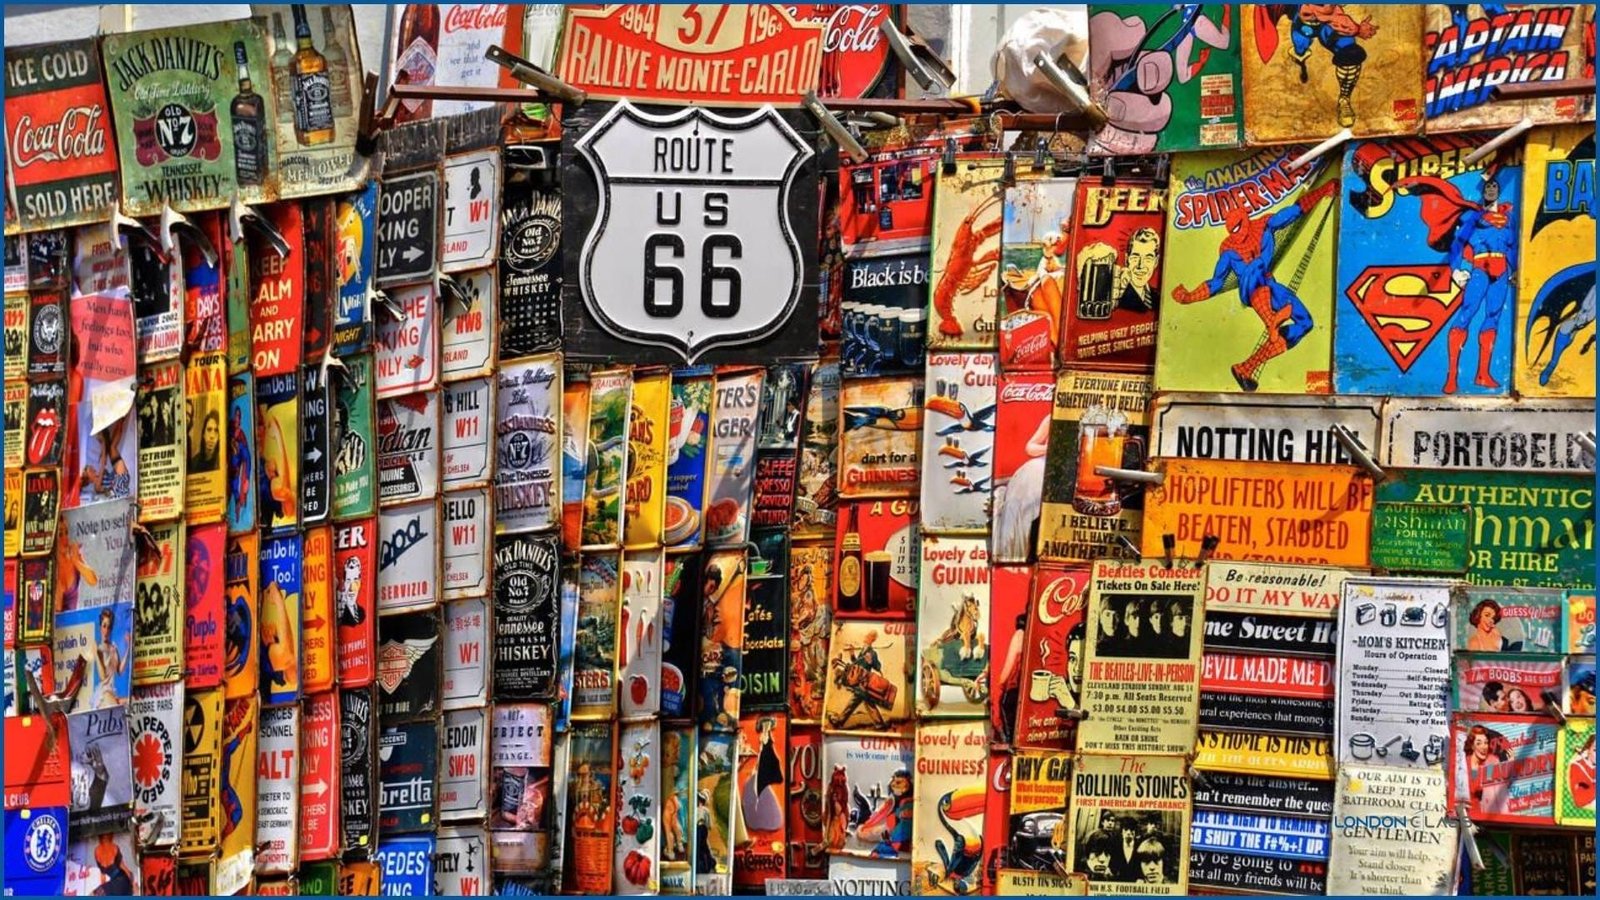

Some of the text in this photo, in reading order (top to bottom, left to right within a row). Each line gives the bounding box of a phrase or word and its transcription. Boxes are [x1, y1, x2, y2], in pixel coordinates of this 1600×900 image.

[619, 4, 783, 46] 1964 37 1964
[10, 50, 88, 87] ICE COLD
[111, 36, 224, 92] JACK DANIEL'S
[573, 25, 819, 95] RALLYE MONTE-CARLO
[653, 137, 734, 174] ROUTE
[160, 162, 203, 175] TENNESSEE
[25, 184, 114, 219] SOLD HERE
[469, 200, 489, 223] W1
[506, 273, 548, 286] Tennessee
[643, 233, 743, 319] 66
[851, 261, 912, 290] Black is
[503, 283, 550, 297] WHISKEY
[260, 305, 279, 316] AND
[81, 317, 114, 337] feelings
[456, 311, 482, 334] NW8
[194, 354, 219, 367] TOUR
[254, 349, 280, 371] ON
[929, 353, 995, 369] Lovely day
[1073, 376, 1151, 392] EVERYONE NEEDS
[456, 391, 479, 412] HILL
[1056, 392, 1104, 409] SOMETHING
[455, 416, 478, 439] W11
[1177, 425, 1294, 463] NOTTING
[861, 453, 906, 465] dart for
[1292, 481, 1341, 512] WILL
[1346, 482, 1373, 514] BE
[1414, 483, 1593, 509] AUTHENTIC
[76, 519, 99, 537] Note
[452, 524, 476, 546] W11
[1177, 512, 1349, 551] BEATEN, STABBED
[273, 540, 286, 559] Do
[924, 546, 964, 563] Lovely
[1042, 540, 1108, 558] ANOTHER
[1097, 564, 1202, 580] Beatles Concert
[1500, 552, 1559, 573] HIRE
[272, 564, 296, 583] Too!
[509, 577, 528, 587] Old
[1226, 569, 1326, 588] Be reasonable!
[381, 580, 428, 601] SERVIZIO
[1096, 580, 1201, 592] Tickets On Sale Here!
[1206, 586, 1342, 610] DO IT MY WAY
[1502, 606, 1528, 617] GUESS
[187, 613, 217, 643] Purple
[1239, 616, 1307, 644] Sweet
[459, 641, 480, 664] W1
[1364, 650, 1438, 662] Hours of Operation
[1089, 661, 1104, 681] THE
[1241, 657, 1315, 687] MADE ME
[1488, 668, 1522, 683] BOOBS
[1087, 682, 1120, 690] CLEVELAND
[157, 699, 173, 712] PARIS
[1136, 692, 1192, 703] Seats Reserved
[85, 710, 124, 737] Pubs
[1219, 709, 1325, 728] experiences that money
[917, 730, 960, 750] Lovely
[1138, 743, 1167, 751] HISTORIC
[449, 754, 475, 778] SW19
[917, 757, 985, 777] GUINNESS
[1017, 757, 1043, 781] MY
[1119, 756, 1146, 774] The
[1076, 774, 1188, 799] ROLLING STONES
[1357, 771, 1407, 784] OUR AIM
[380, 777, 432, 806] bretta
[1222, 791, 1303, 810] remember the
[1368, 785, 1427, 798] KEEP THIS
[1076, 798, 1187, 810] FIRST AMERICAN APPEARANCE
[1343, 795, 1406, 810] BATHROOM
[1204, 828, 1261, 849] SHUT THE
[1343, 826, 1441, 845] GENTLEMEN
[1348, 845, 1407, 860] Your aim will
[1232, 856, 1274, 873] going
[1358, 859, 1385, 871] Stand
[1012, 876, 1073, 889] RUSTY SIGNS
[1224, 870, 1308, 891] my friends will
[1367, 872, 1422, 885] shorter than
[1116, 885, 1149, 894] FOOTBALL
